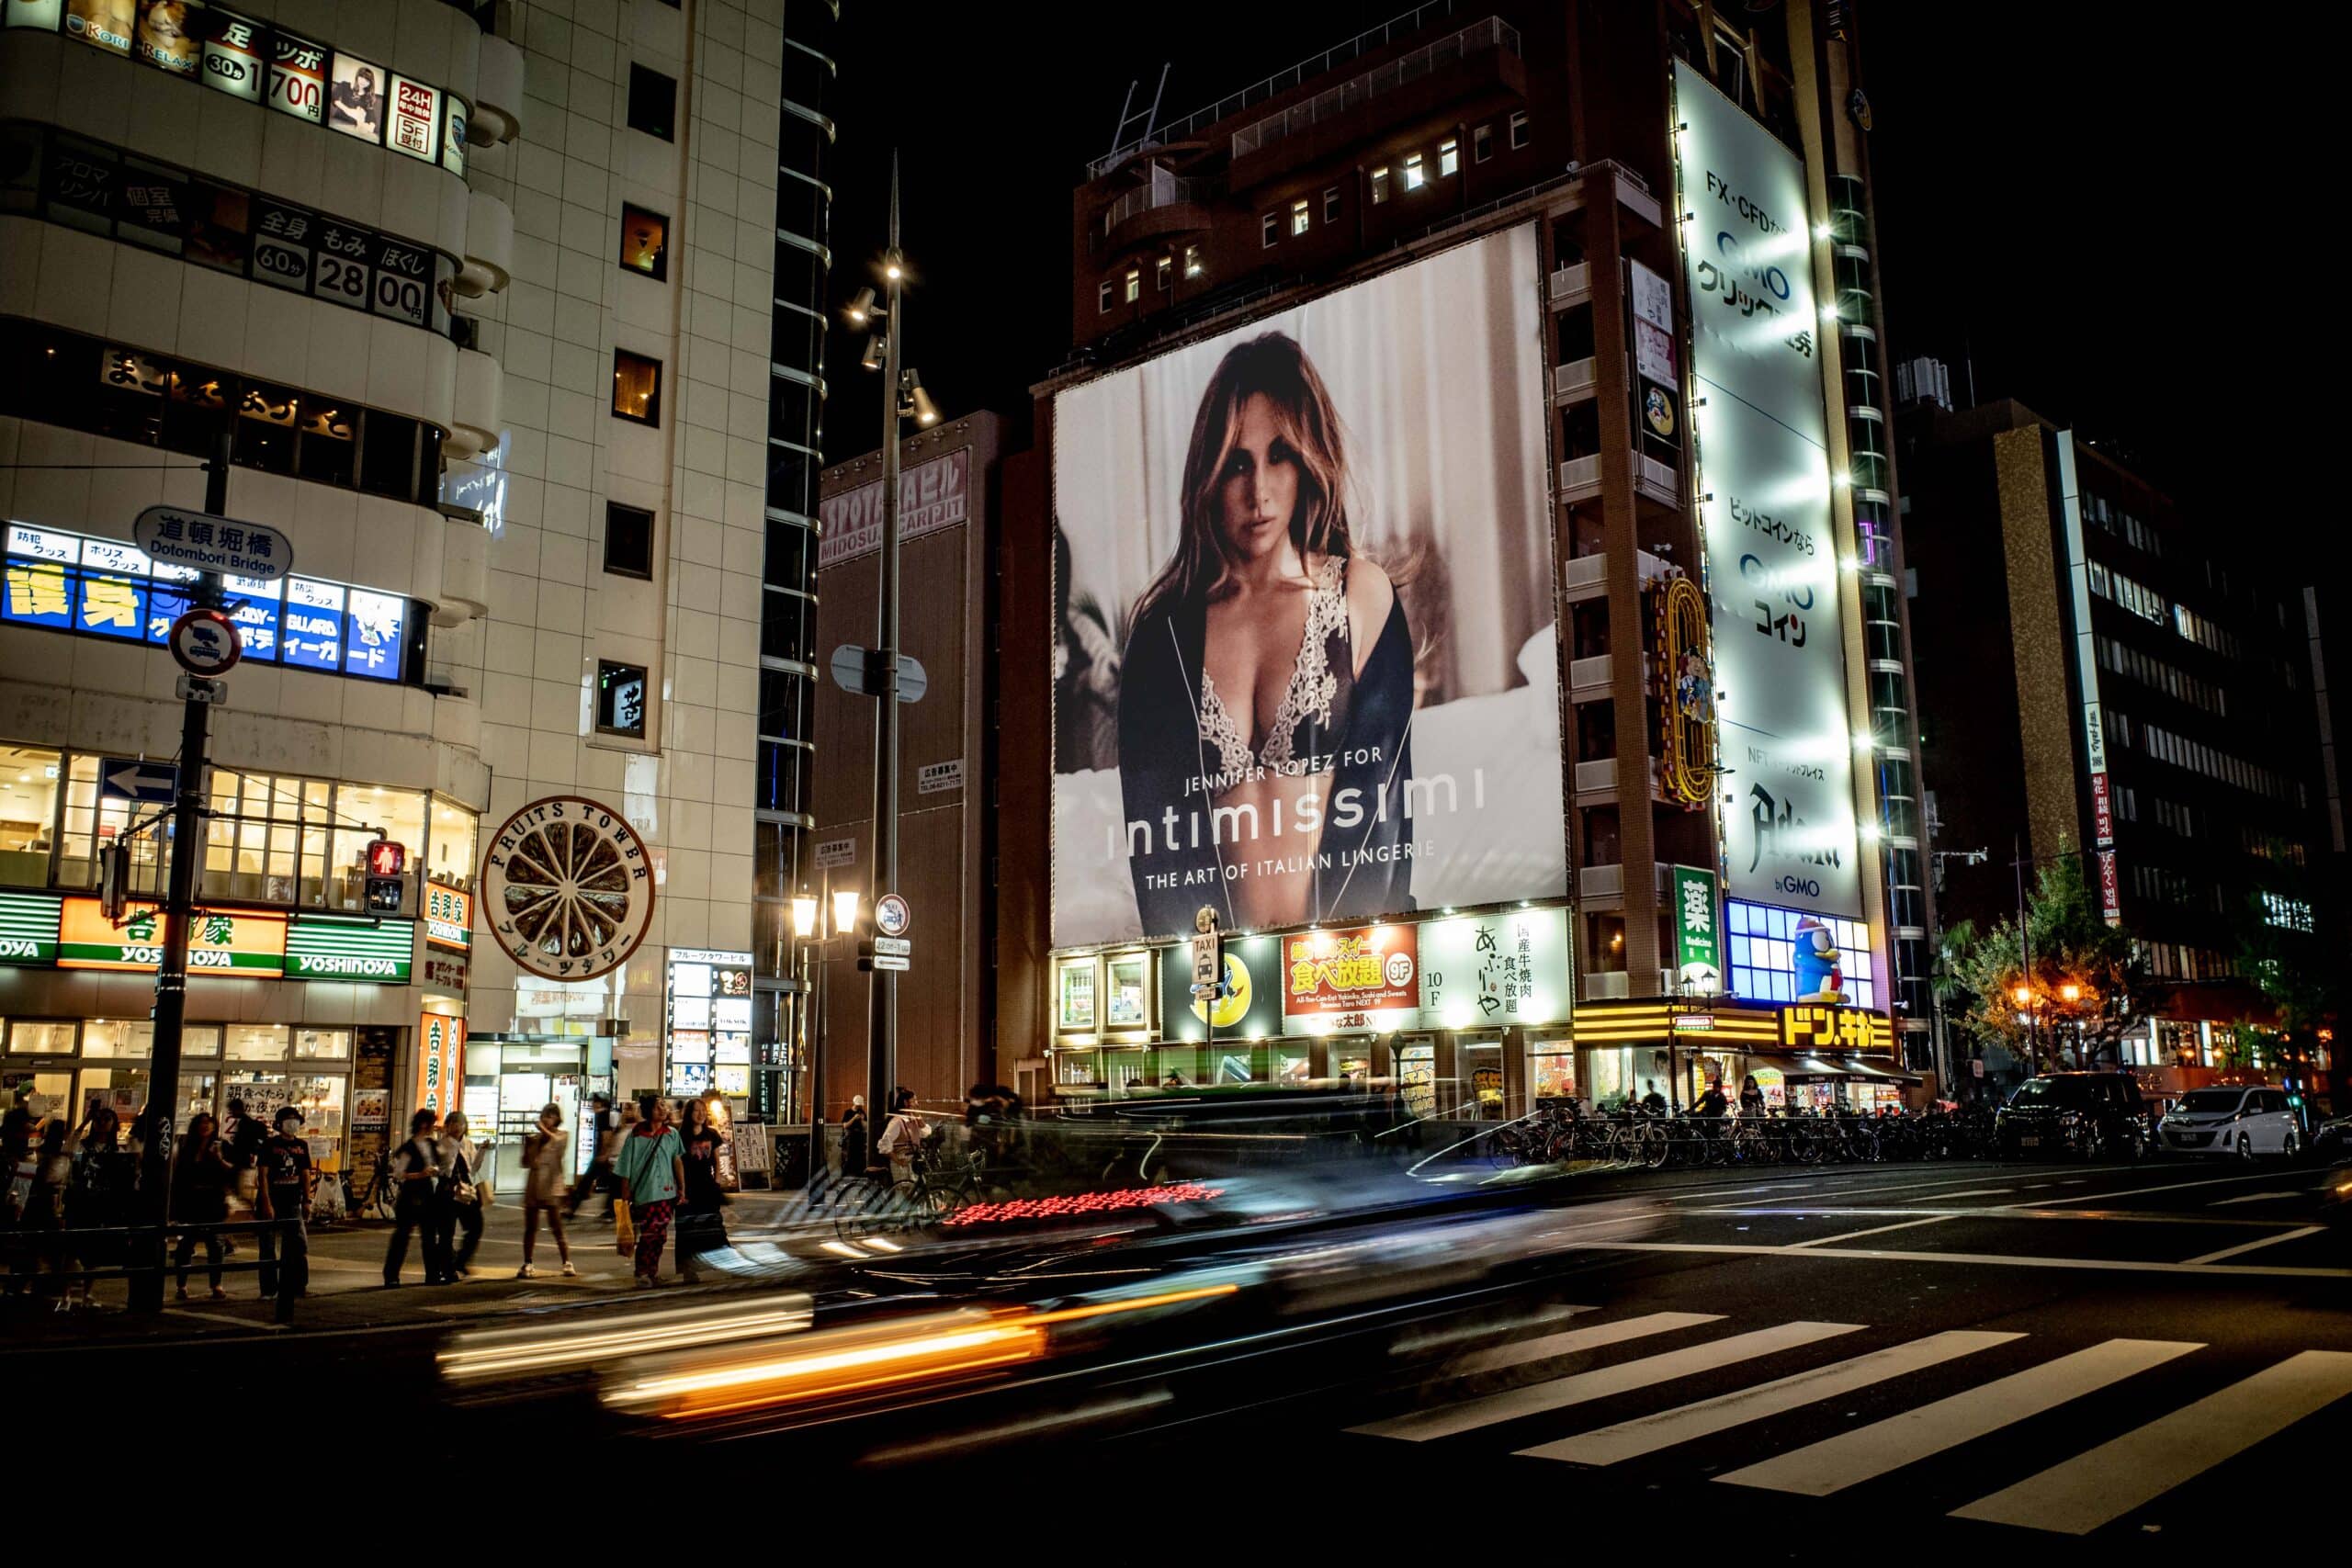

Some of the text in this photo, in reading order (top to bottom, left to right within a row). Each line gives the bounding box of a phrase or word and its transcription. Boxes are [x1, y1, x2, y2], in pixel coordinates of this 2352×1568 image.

[401, 86, 431, 109] 24H
[402, 120, 424, 136] 5F
[158, 515, 273, 558] 道頓堀橋
[1730, 496, 1815, 557] ビットコインなら
[151, 539, 276, 575] Dotombori Bridge
[1754, 598, 1807, 649] コイン
[1183, 747, 1383, 797] JENNIFER LOPEZ FOR
[1106, 768, 1485, 860] intimissimi
[490, 802, 647, 879] FRUITS TOWER
[1146, 840, 1435, 890] THE ART OF ITALIAN LINGERIE
[1783, 874, 1820, 897] GMO
[1682, 879, 1711, 933] 薬
[299, 955, 398, 976] YOSHINOYA
[1195, 937, 1215, 953] TAXI
[1291, 955, 1385, 995] 食べ放題
[1388, 961, 1411, 981] 9F
[1475, 925, 1503, 1017] あぶりや
[1504, 955, 1518, 1014] 食べ放題
